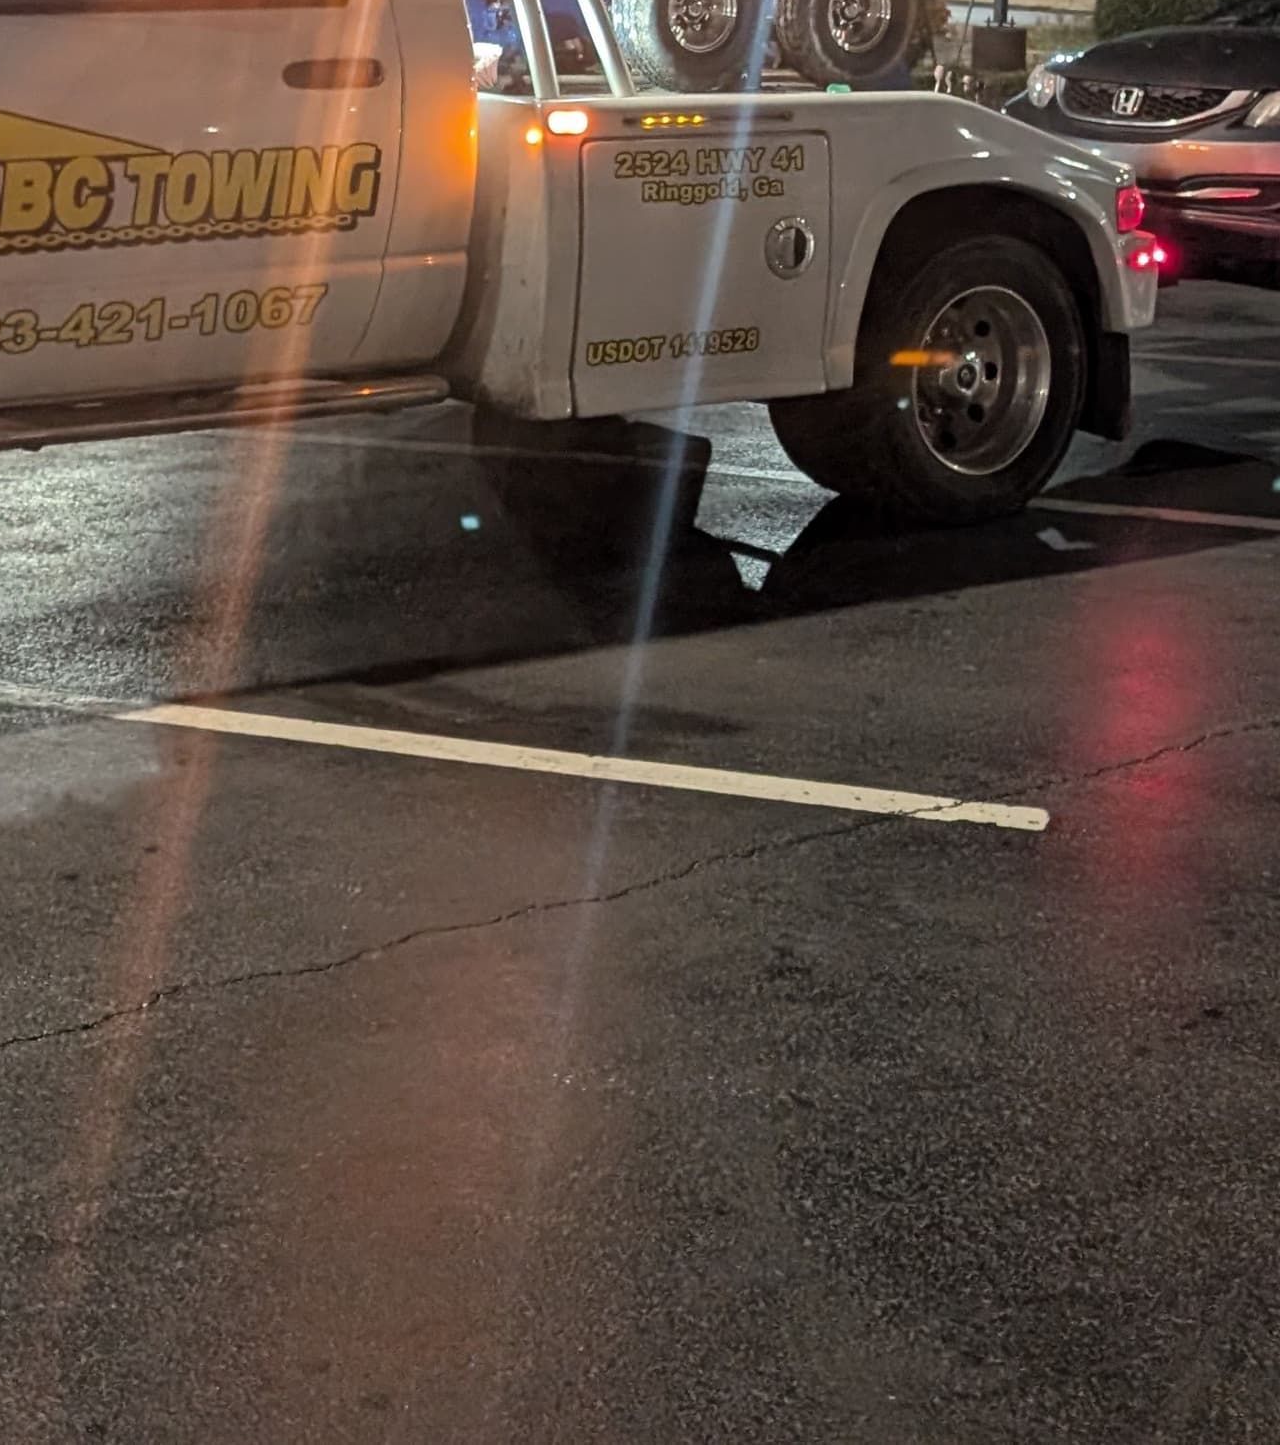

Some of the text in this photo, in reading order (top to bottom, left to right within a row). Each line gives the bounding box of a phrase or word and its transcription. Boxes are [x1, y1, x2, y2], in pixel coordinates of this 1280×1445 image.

[615, 144, 805, 179] 2524 HWY 41
[124, 143, 381, 228] TOWING
[641, 176, 785, 206] Ringgold, Ga
[586, 335, 666, 366] USDOT
